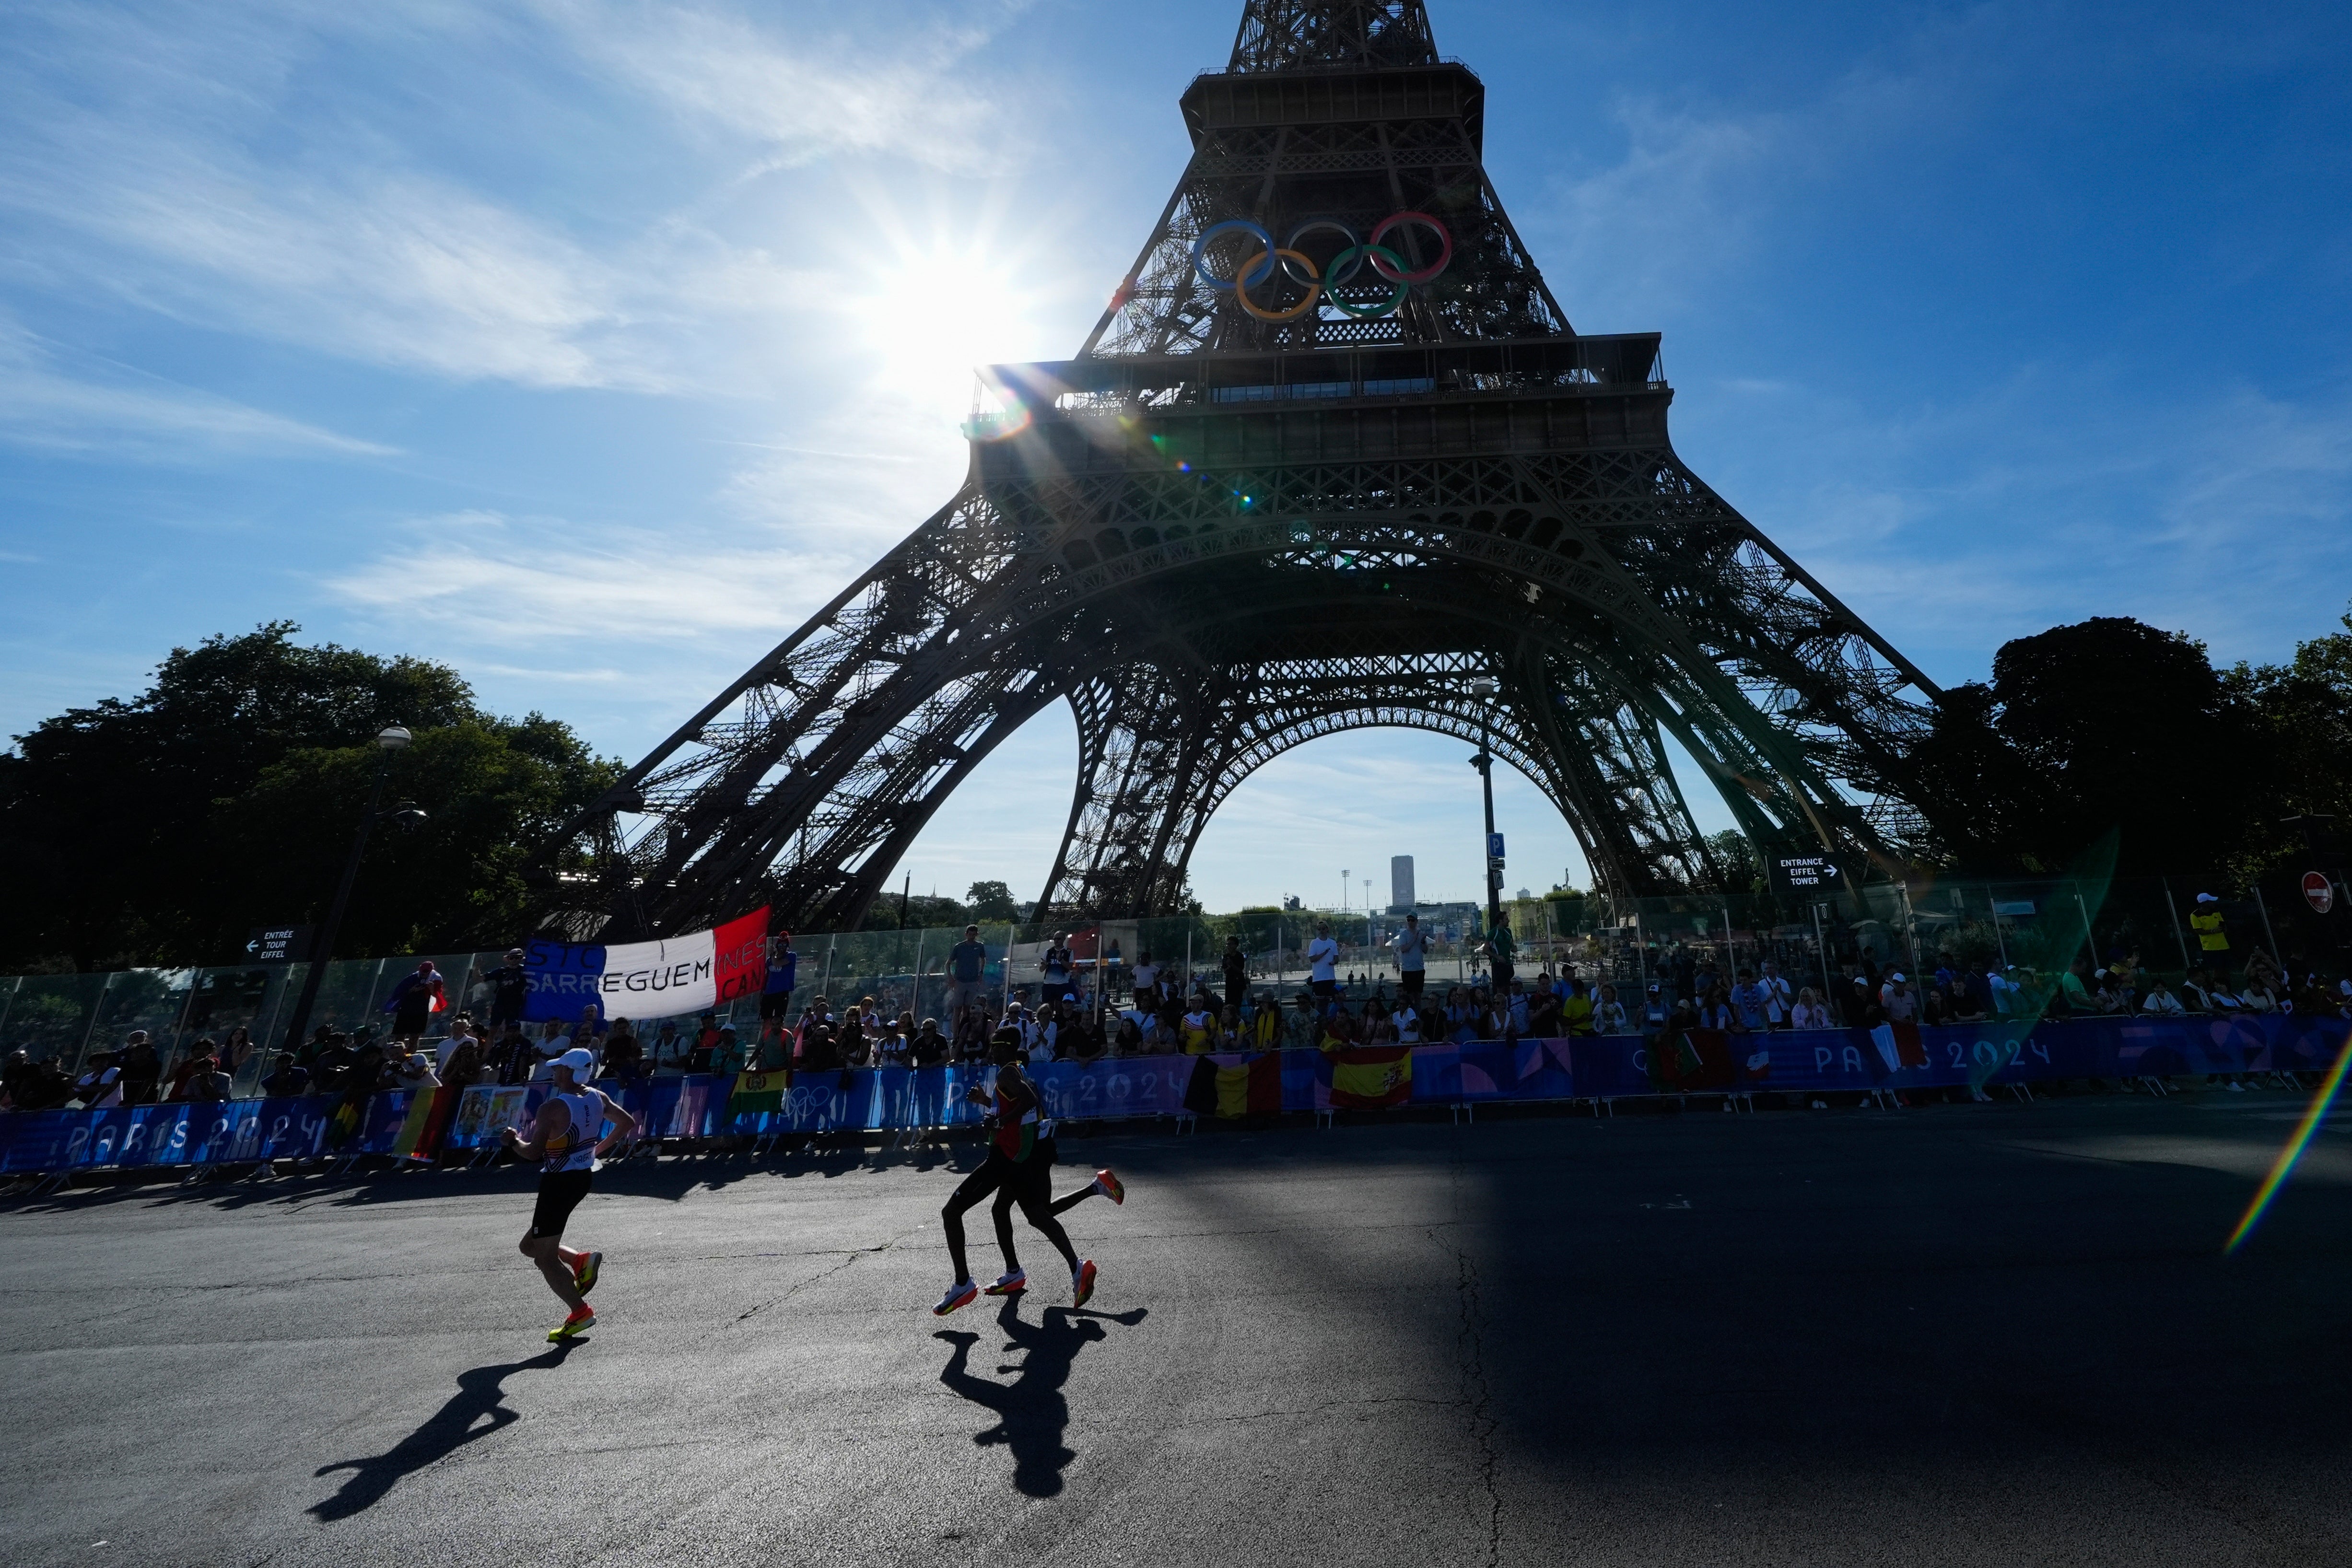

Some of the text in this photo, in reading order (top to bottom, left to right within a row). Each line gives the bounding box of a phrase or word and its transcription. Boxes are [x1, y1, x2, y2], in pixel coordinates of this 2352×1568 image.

[1493, 838, 1500, 853] P
[1780, 857, 1824, 867] ENTRANCE
[1790, 867, 1817, 876] EIFFEL
[1790, 877, 1819, 885] TOWER
[264, 929, 294, 940] ENTRÉE
[266, 940, 287, 949] TOUR
[260, 950, 285, 959] EIFFEL
[521, 933, 766, 994] SARREGUEMINES
[1947, 1038, 2050, 1069] 2024
[1079, 1071, 1184, 1101] 2024
[207, 1113, 317, 1146] 2024
